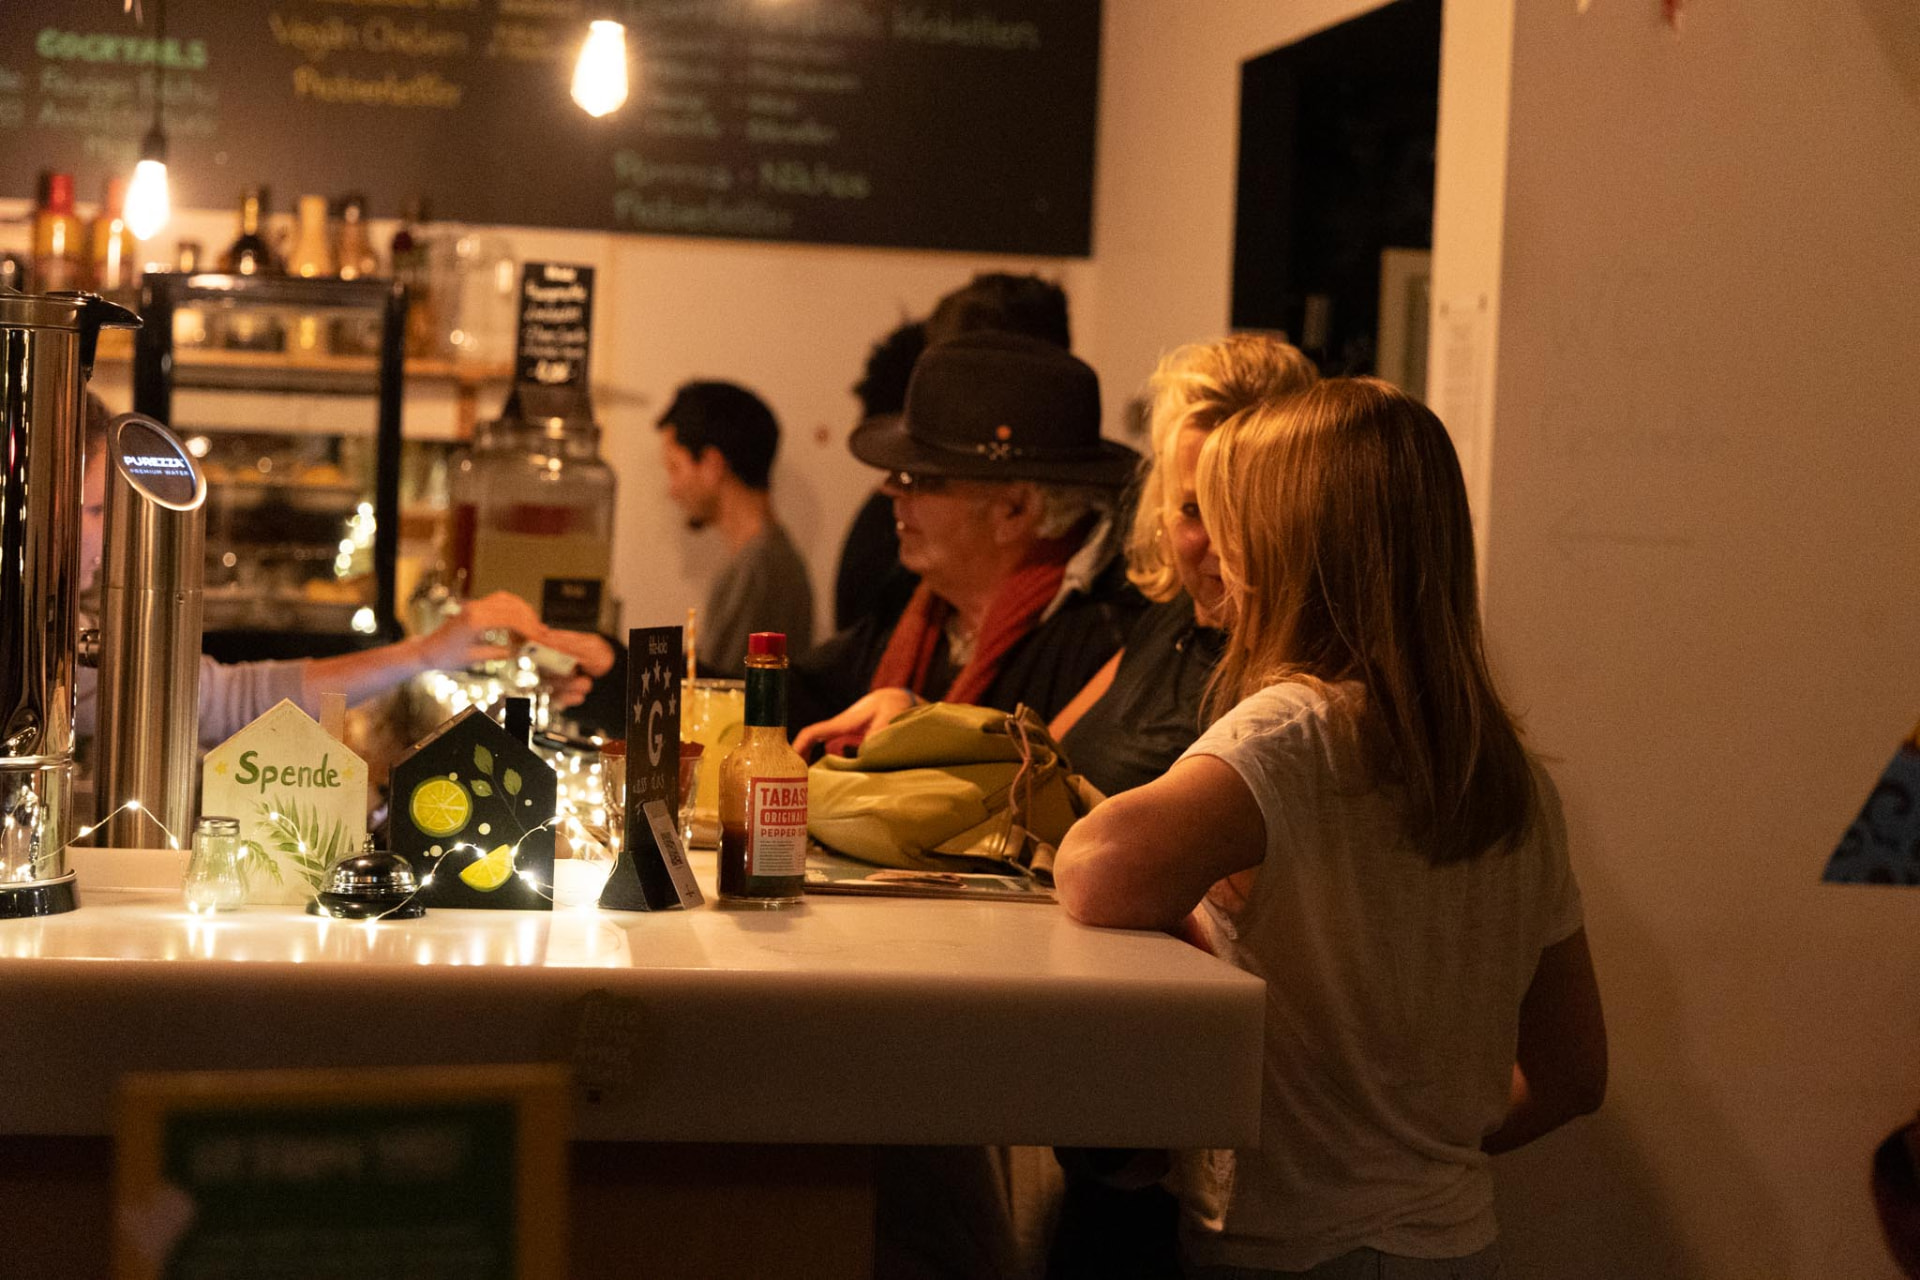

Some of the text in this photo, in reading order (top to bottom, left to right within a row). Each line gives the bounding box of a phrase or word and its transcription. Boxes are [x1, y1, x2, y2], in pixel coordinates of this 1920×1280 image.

[123, 456, 186, 468] PUREZZA
[235, 750, 341, 794] Spende
[761, 828, 796, 838] PEPPER
